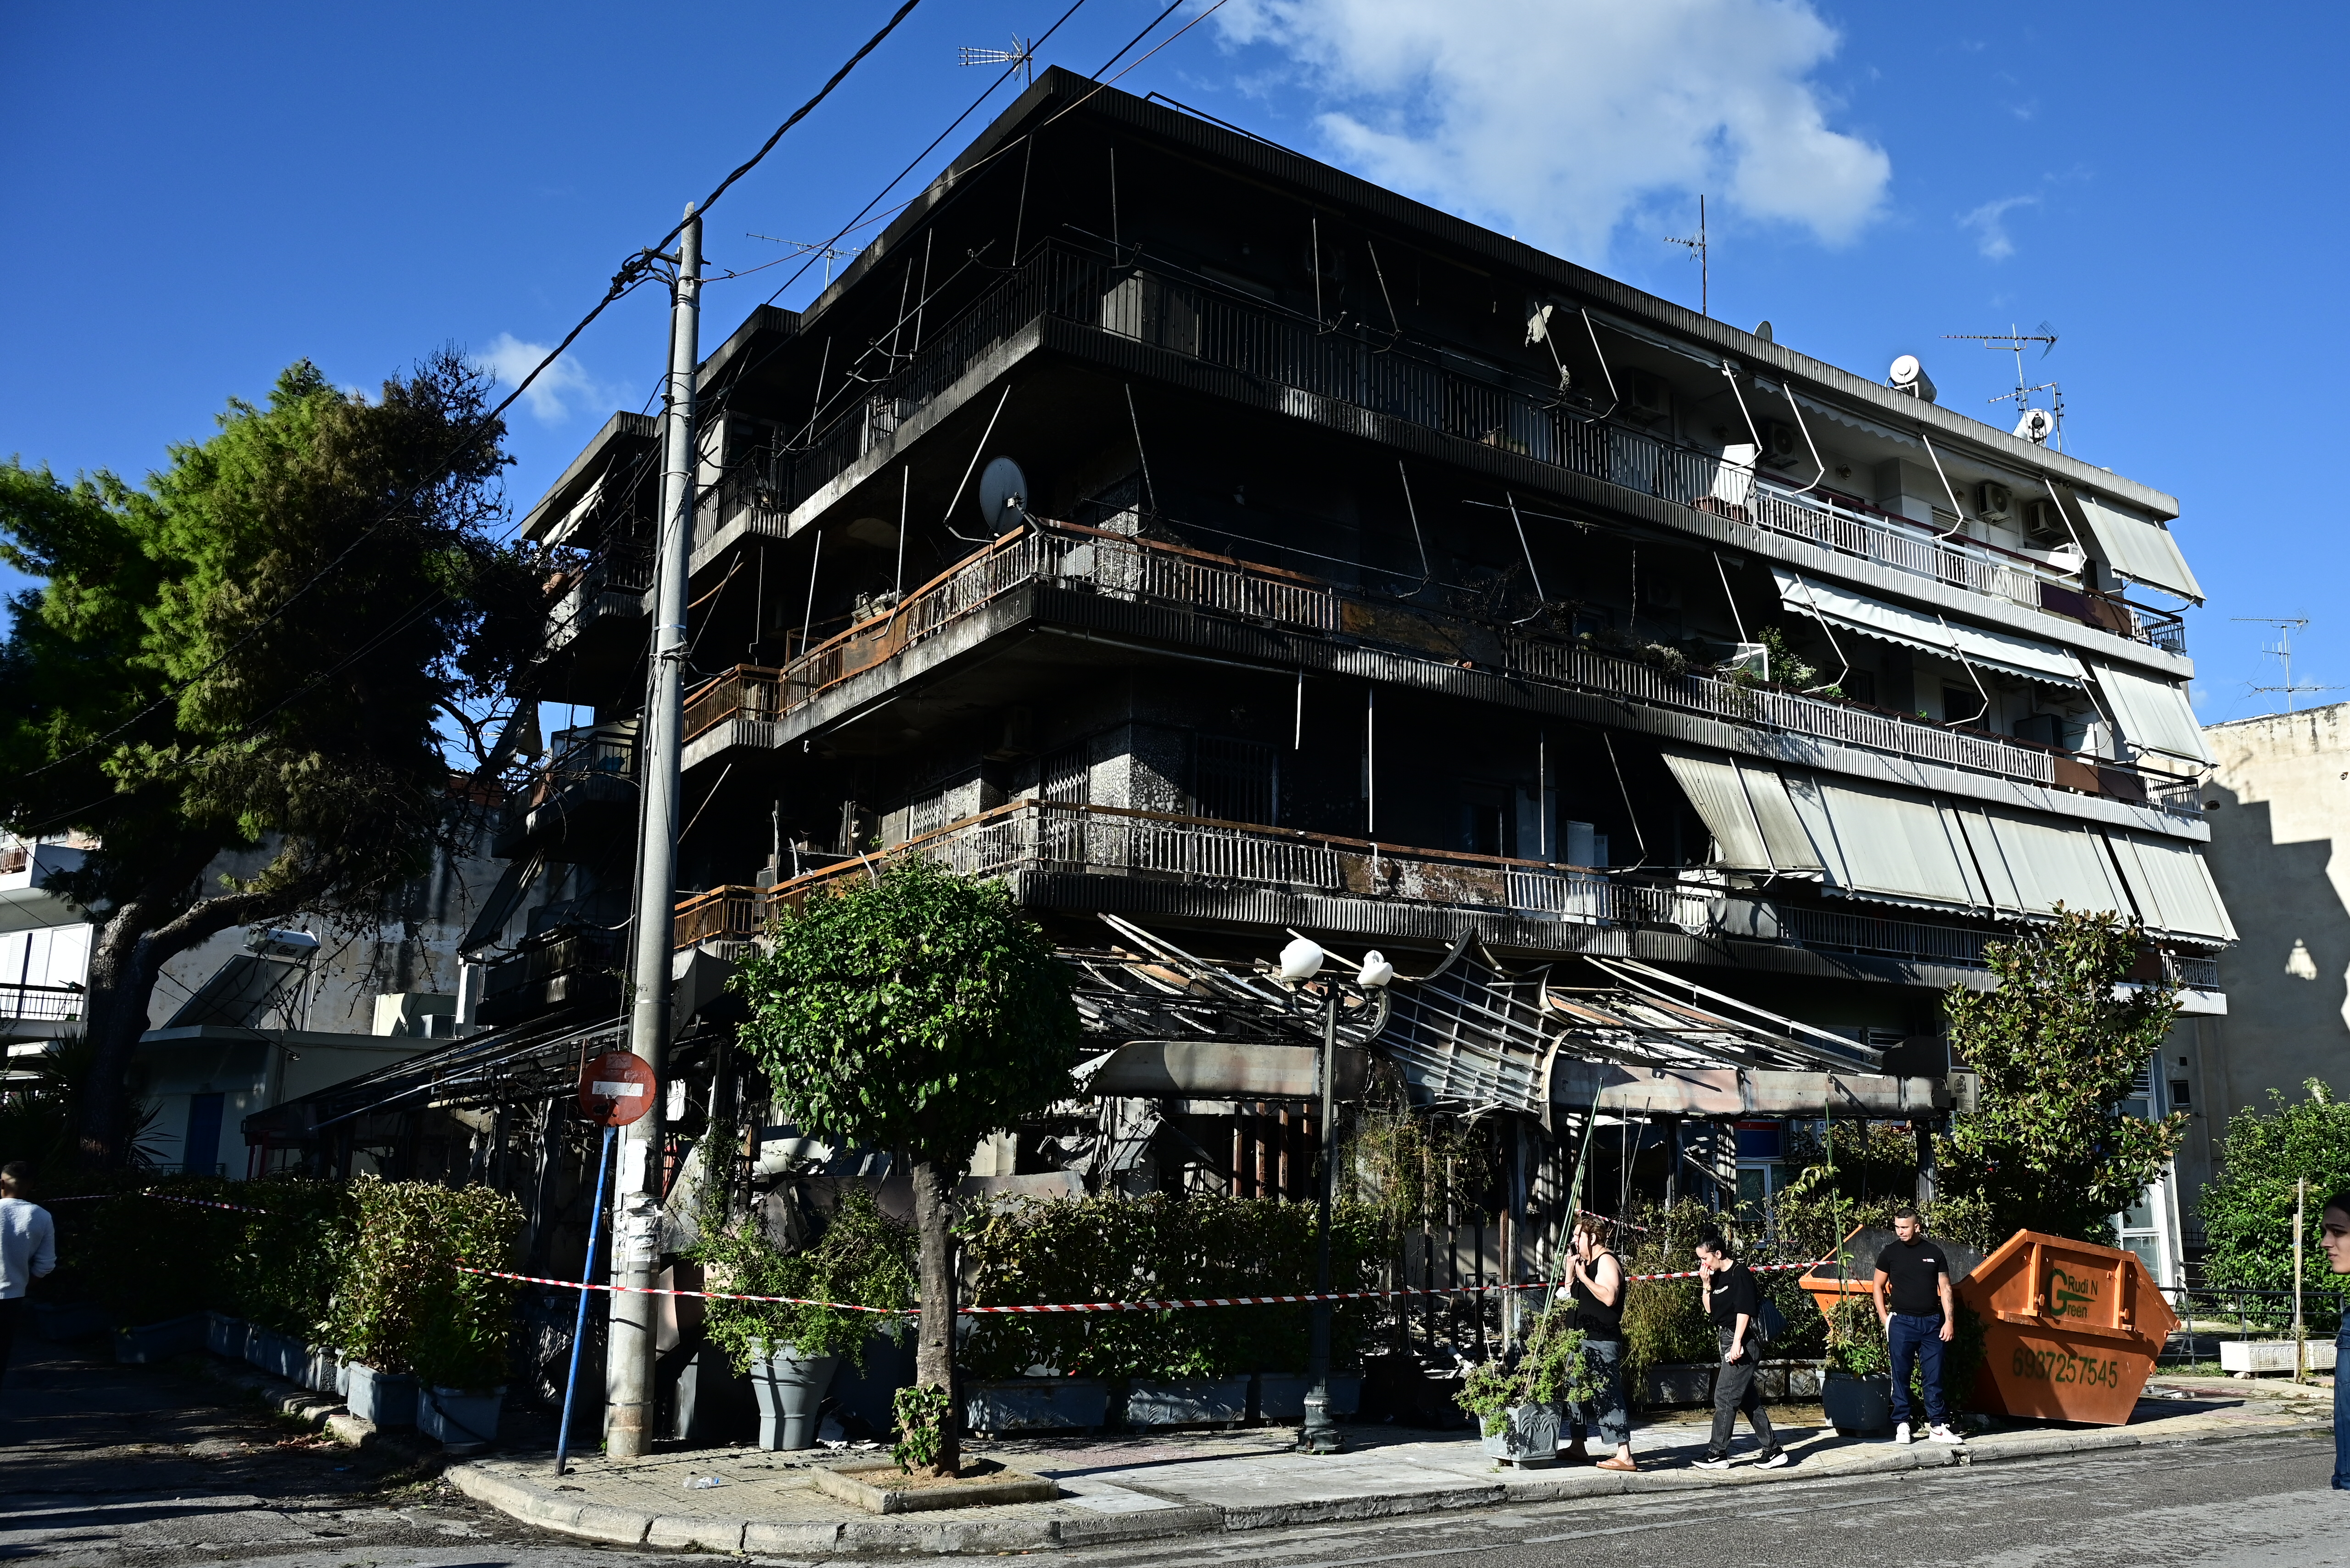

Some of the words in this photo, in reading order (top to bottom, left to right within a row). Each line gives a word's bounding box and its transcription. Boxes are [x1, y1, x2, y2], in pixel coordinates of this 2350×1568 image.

[276, 945, 298, 956] Calpak
[2068, 1276, 2088, 1294] Rudi
[2091, 1280, 2098, 1295] N
[2013, 1347, 2117, 1389] 6937257545
